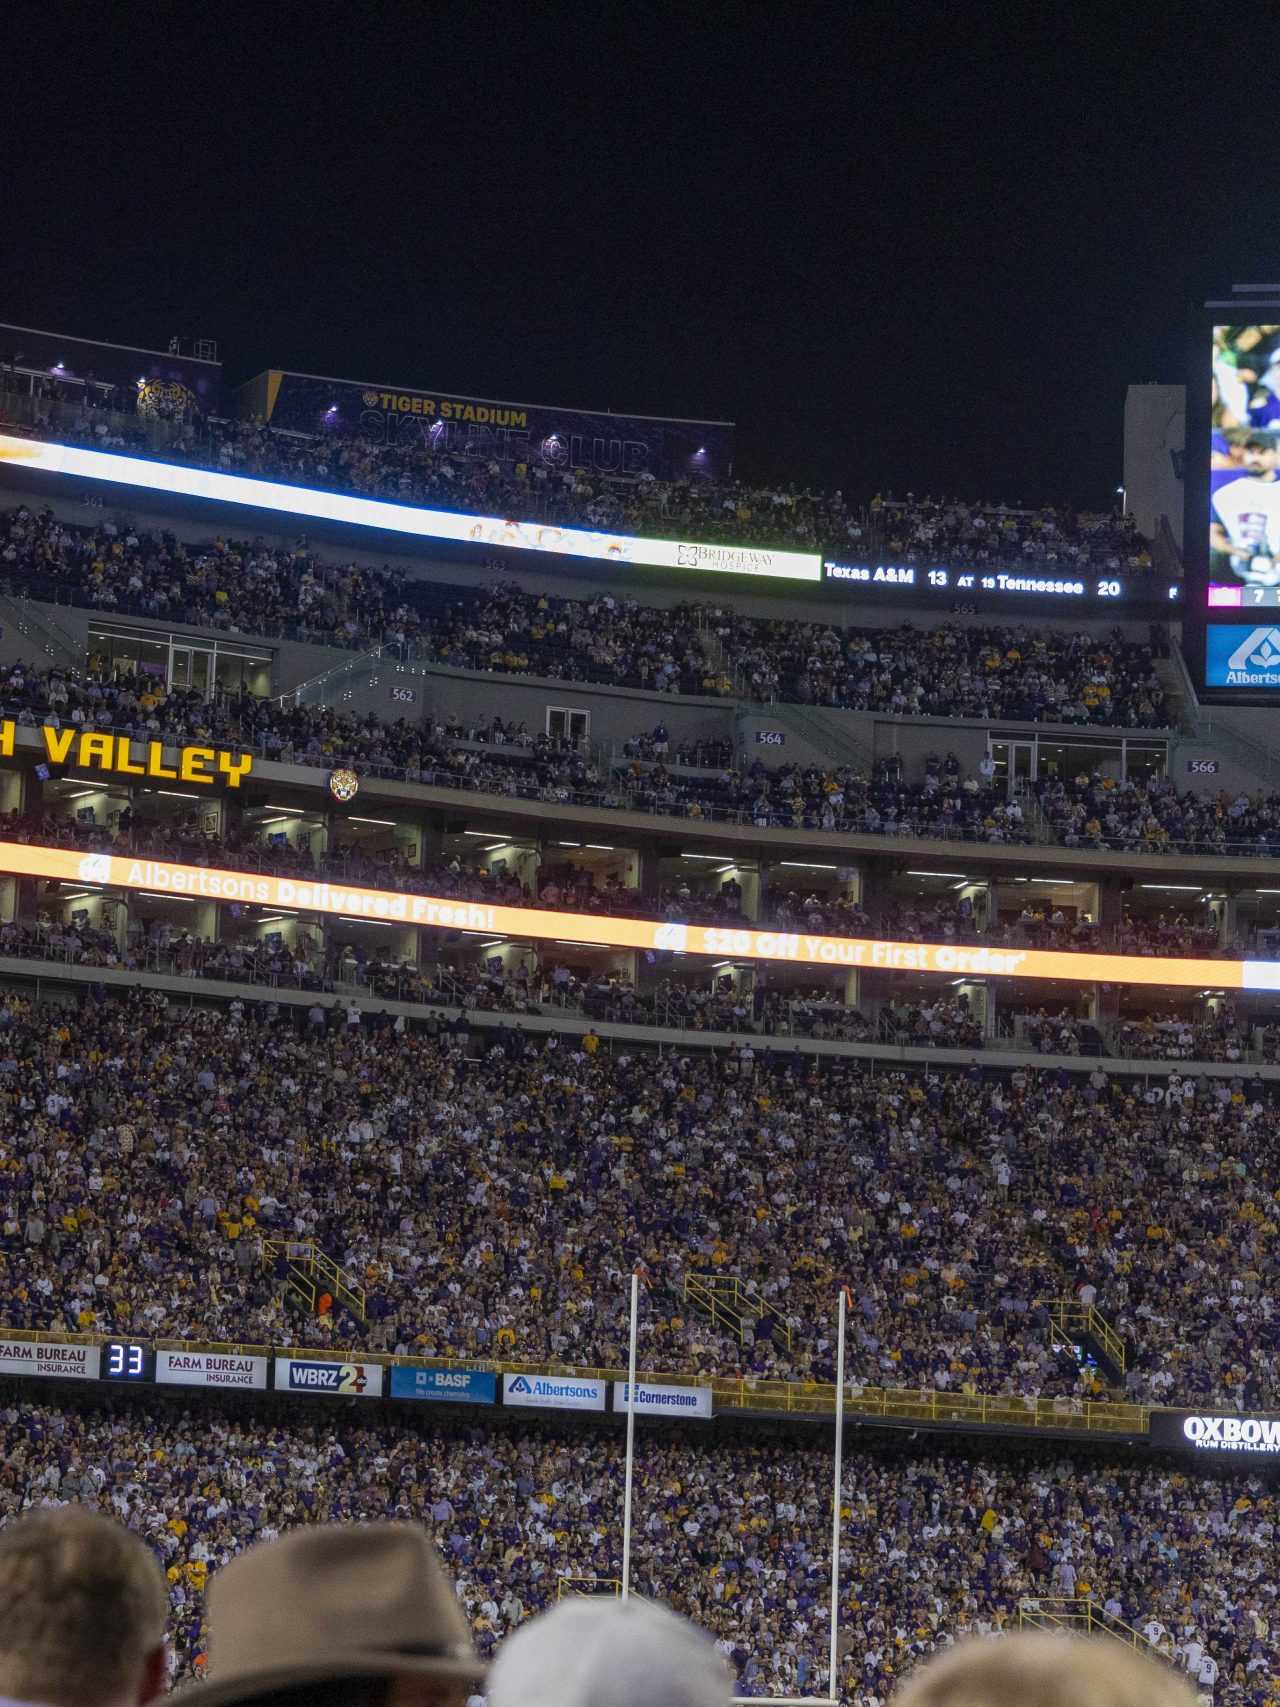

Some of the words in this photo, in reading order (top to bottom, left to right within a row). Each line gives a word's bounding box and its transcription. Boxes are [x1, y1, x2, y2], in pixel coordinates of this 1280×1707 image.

[380, 393, 436, 416] TIGER
[440, 402, 527, 427] STADIUM
[541, 431, 648, 475] CLUB
[698, 546, 773, 566] BRIDGEWAY
[824, 563, 869, 581] Texas
[873, 566, 914, 583] A&M
[928, 570, 948, 586] 13
[956, 576, 974, 588] AT
[981, 577, 996, 589] 19
[997, 575, 1084, 594] Tennessee
[1098, 581, 1121, 596] 20
[1253, 589, 1264, 603] 7
[393, 688, 414, 702] 562
[760, 732, 781, 745] 564
[41, 725, 253, 788] VALLEY
[1192, 761, 1215, 773] 566
[128, 862, 270, 900] Albertsons
[277, 880, 407, 918] Delivered
[413, 899, 496, 929] Fresh!
[805, 938, 864, 964] Your
[872, 942, 928, 968] First
[36, 1347, 86, 1362] BUREAU
[109, 1344, 143, 1374] 33
[37, 1363, 86, 1375] INSURANCE
[169, 1356, 202, 1369] FARM
[206, 1358, 254, 1373] BUREAU
[206, 1374, 253, 1385] INSURANCE
[292, 1367, 337, 1386] WBRZ
[435, 1372, 471, 1388] BASF
[533, 1381, 598, 1400] Albertsons
[640, 1391, 697, 1407] Cornerstone
[1184, 1417, 1280, 1444] OXBOW
[1195, 1440, 1219, 1449] RUM
[1221, 1442, 1280, 1452] DISTILLERY
[1153, 1626, 1159, 1636] 9
[1206, 1663, 1212, 1673] 9
